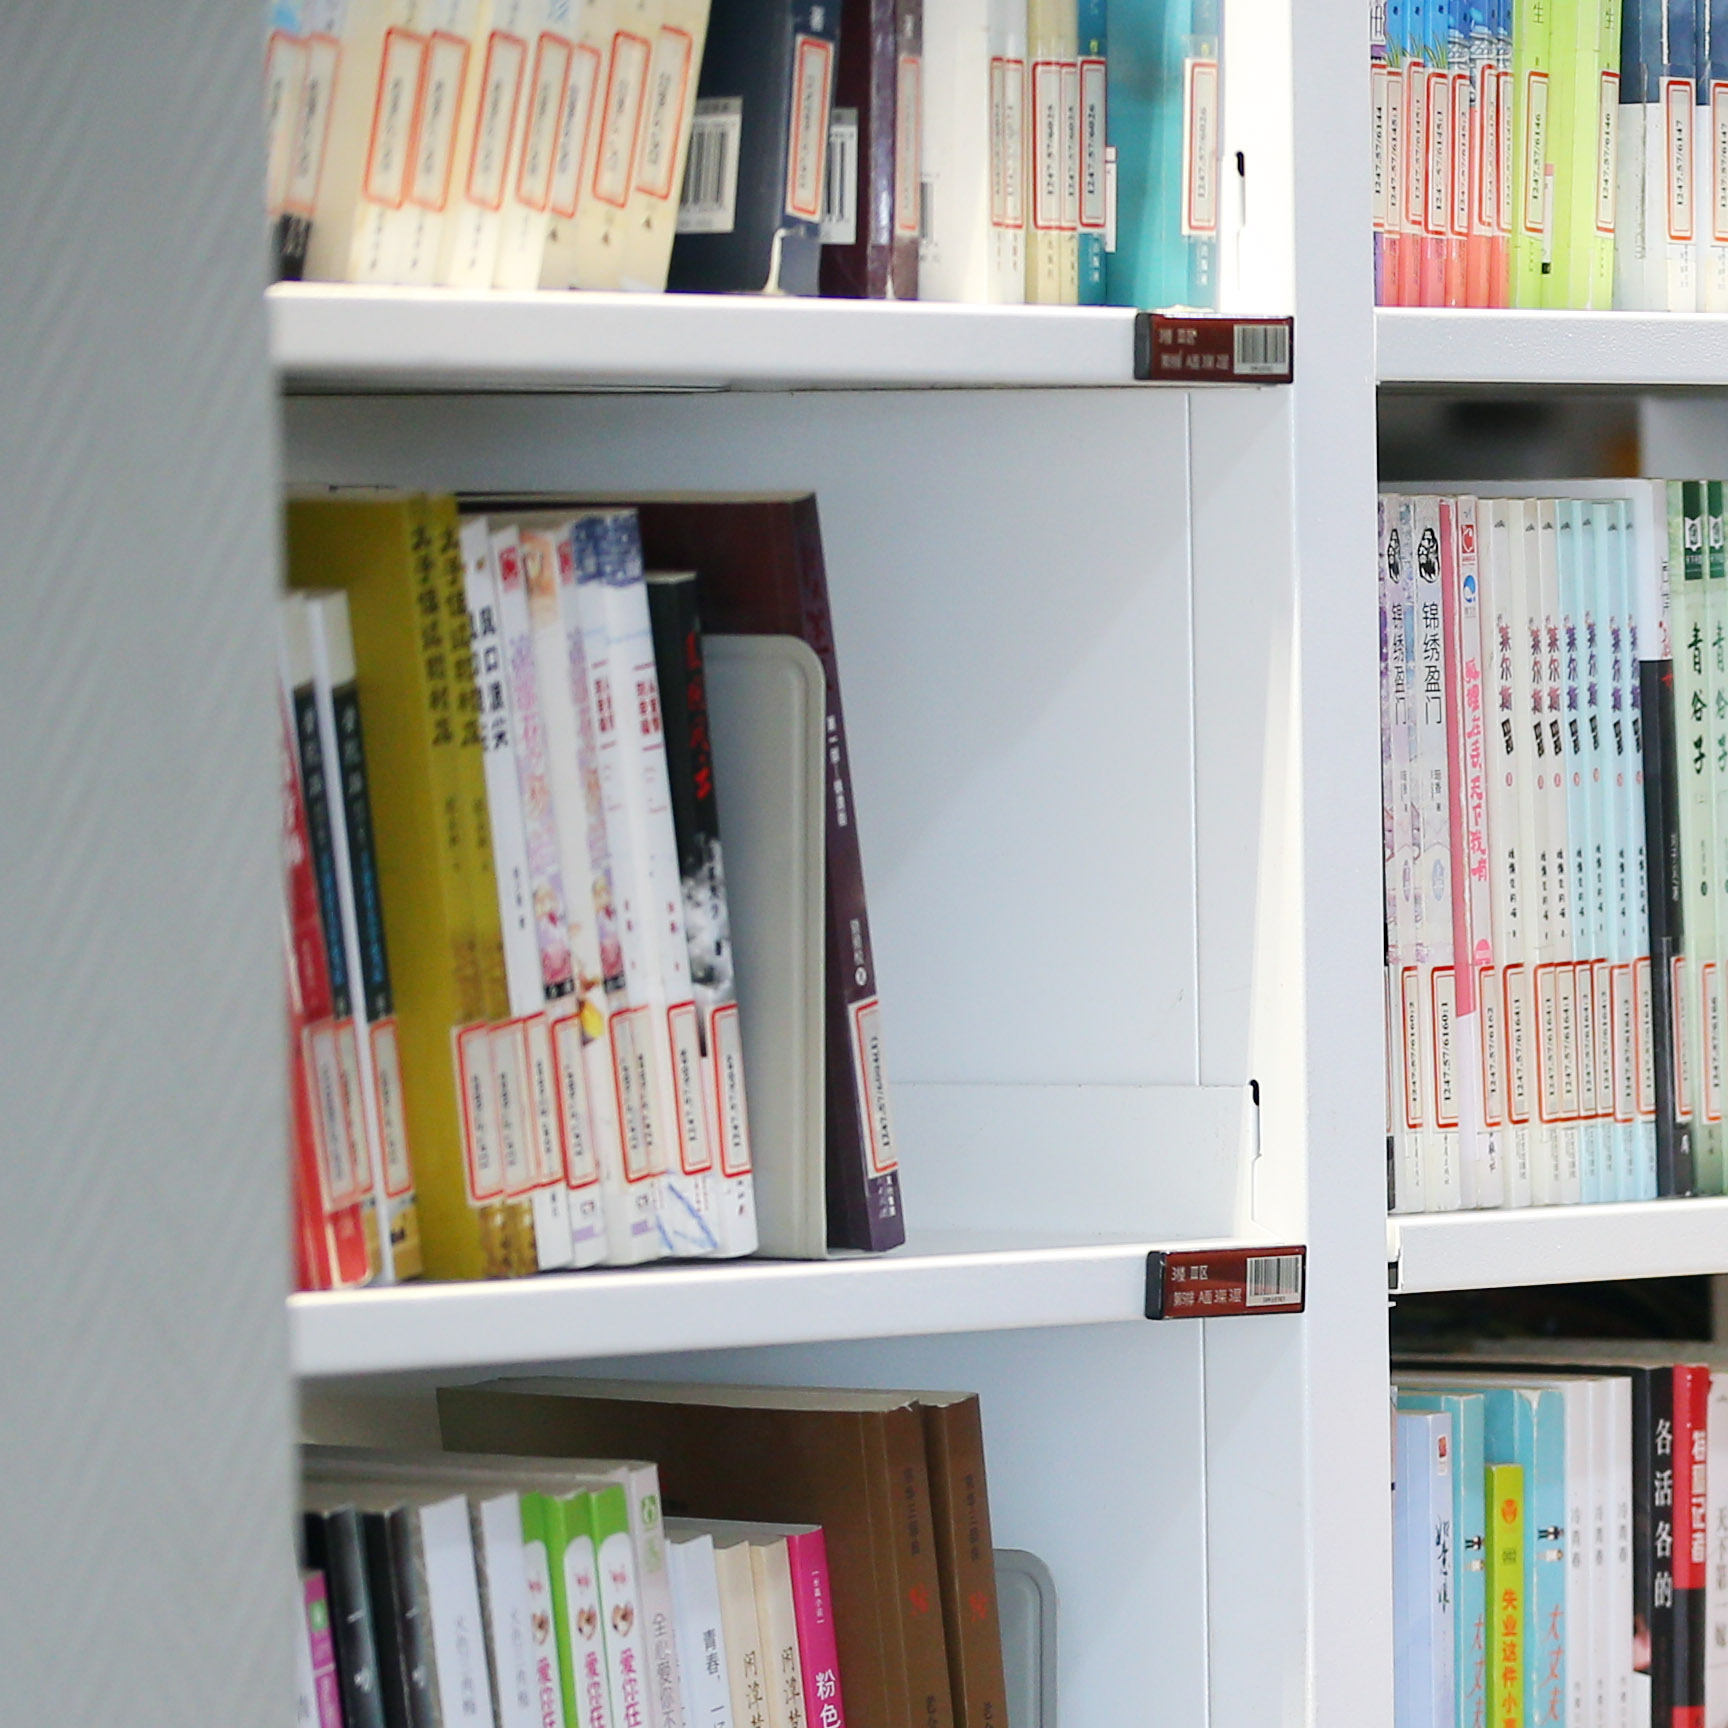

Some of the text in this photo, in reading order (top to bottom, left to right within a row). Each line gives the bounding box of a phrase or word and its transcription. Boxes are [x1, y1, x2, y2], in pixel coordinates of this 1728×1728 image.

[1675, 119, 1684, 207] I247.57/6147
[1391, 602, 1408, 727] 锦绣盈门
[1422, 601, 1444, 726] 锦绣盈门
[1441, 1001, 1453, 1102] I247.57/6160:1
[1653, 1417, 1673, 1610] 各活各的
